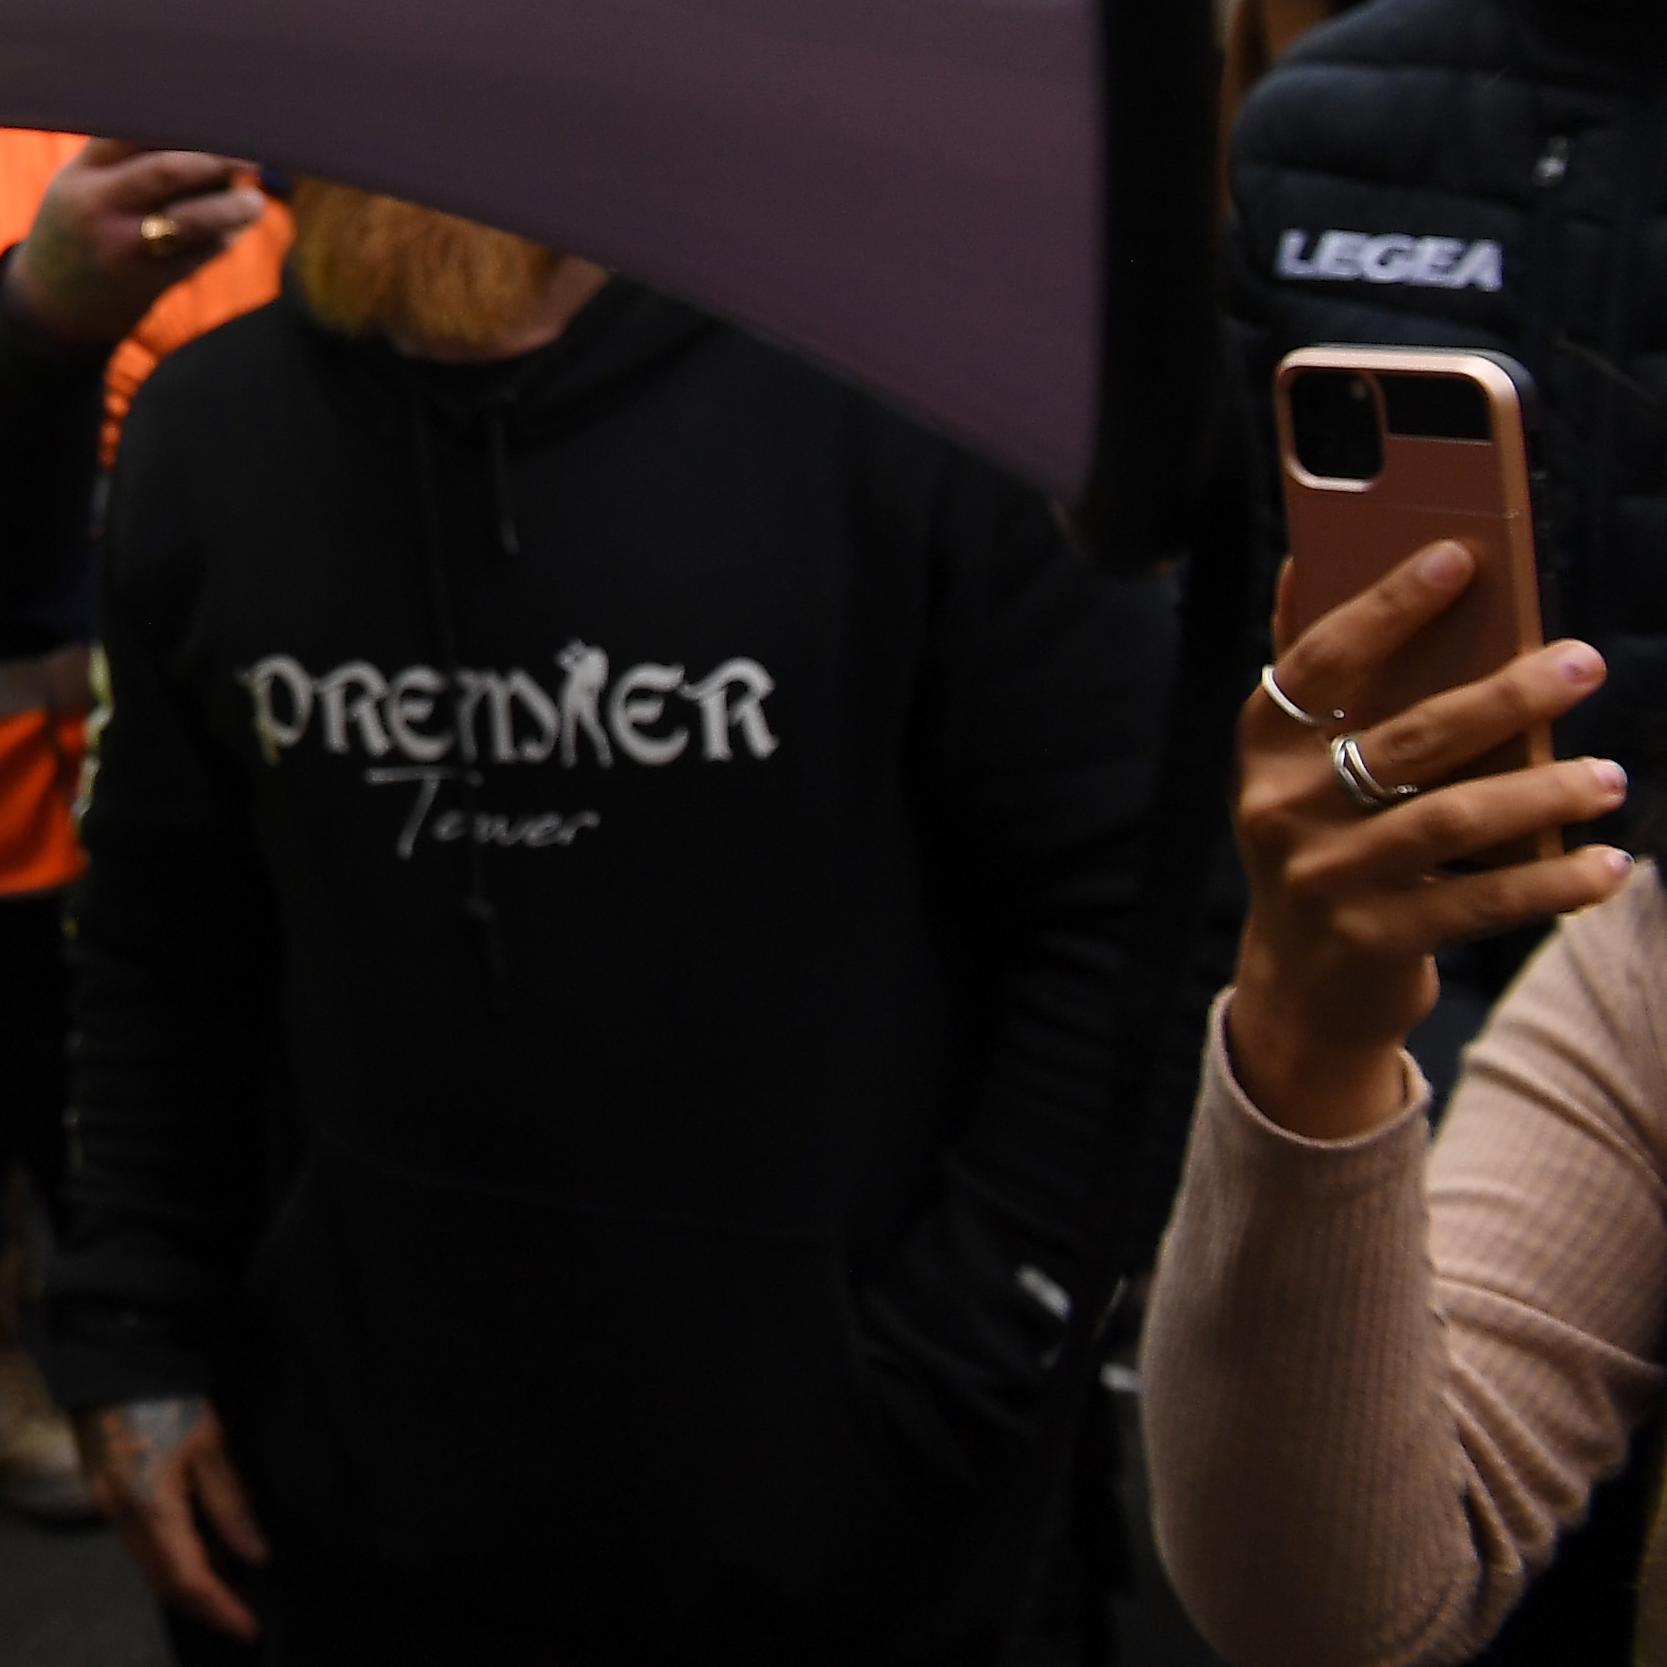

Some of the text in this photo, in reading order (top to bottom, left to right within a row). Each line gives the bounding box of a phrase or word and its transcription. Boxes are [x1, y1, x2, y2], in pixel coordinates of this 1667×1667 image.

[1275, 228, 1504, 292] LEGEA
[241, 641, 778, 767] PREMIER
[364, 766, 600, 860] Tower
